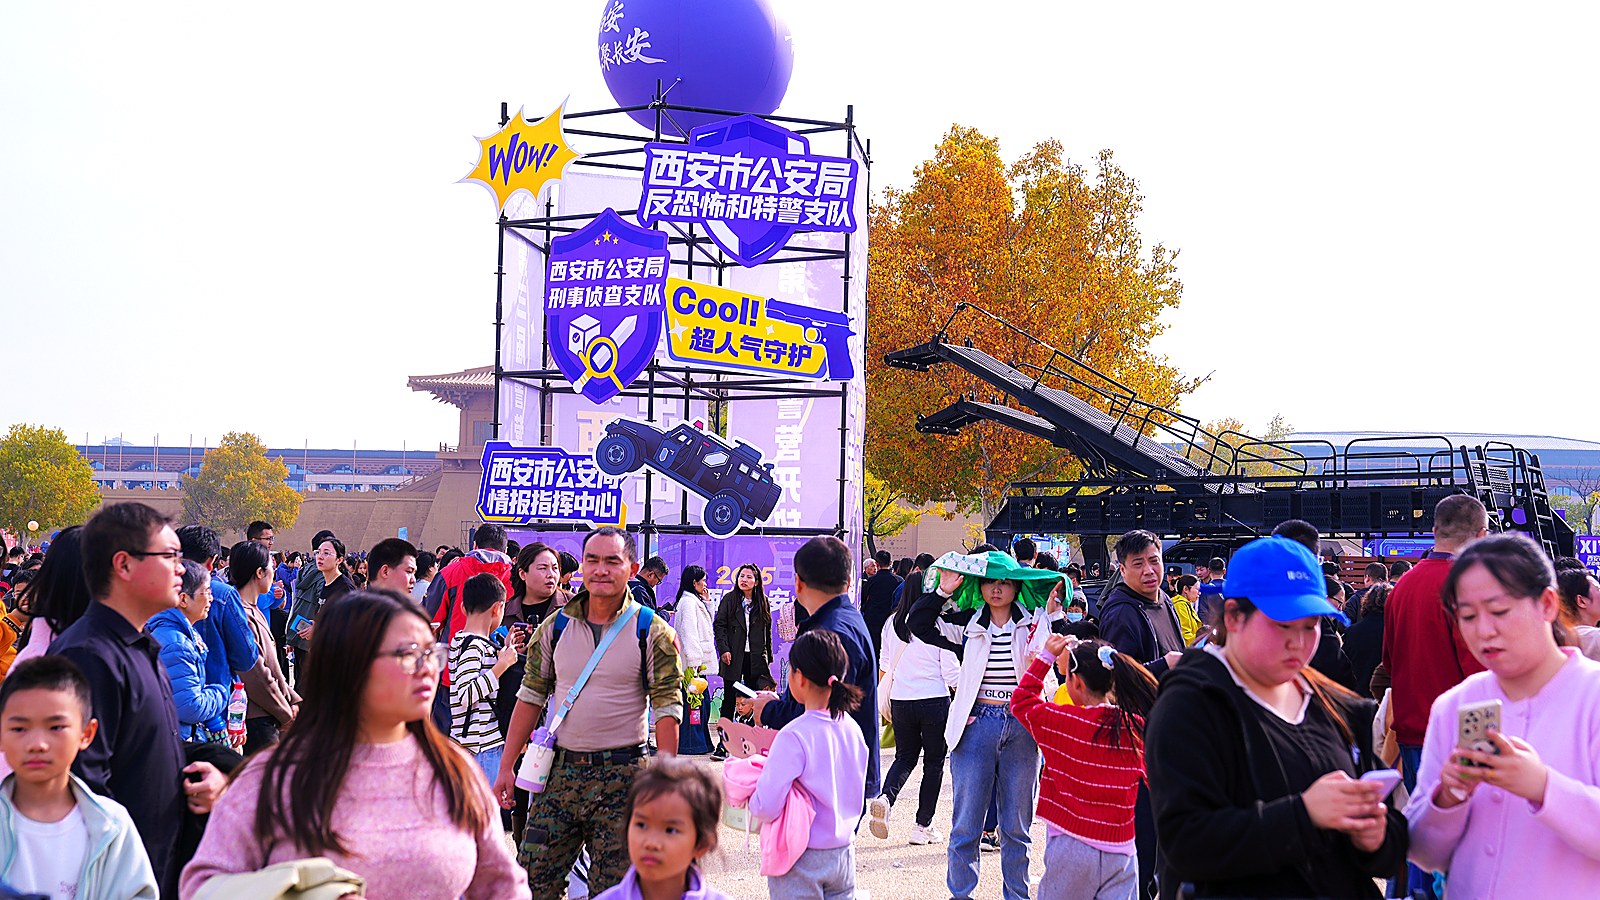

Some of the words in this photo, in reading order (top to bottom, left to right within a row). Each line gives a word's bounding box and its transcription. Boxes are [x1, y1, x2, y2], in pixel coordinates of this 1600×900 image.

[651, 151, 854, 198] 西安市公安局
[646, 190, 853, 229] 反恐怖和特警支队
[549, 256, 665, 283] 西安市公安局
[548, 283, 662, 310] 刑事侦查支队
[672, 286, 760, 327] Cool!
[689, 325, 813, 368] 超人气守护
[486, 488, 617, 518] 情报指挥中心
[1580, 540, 1600, 554] XI
[716, 565, 777, 585] 25
